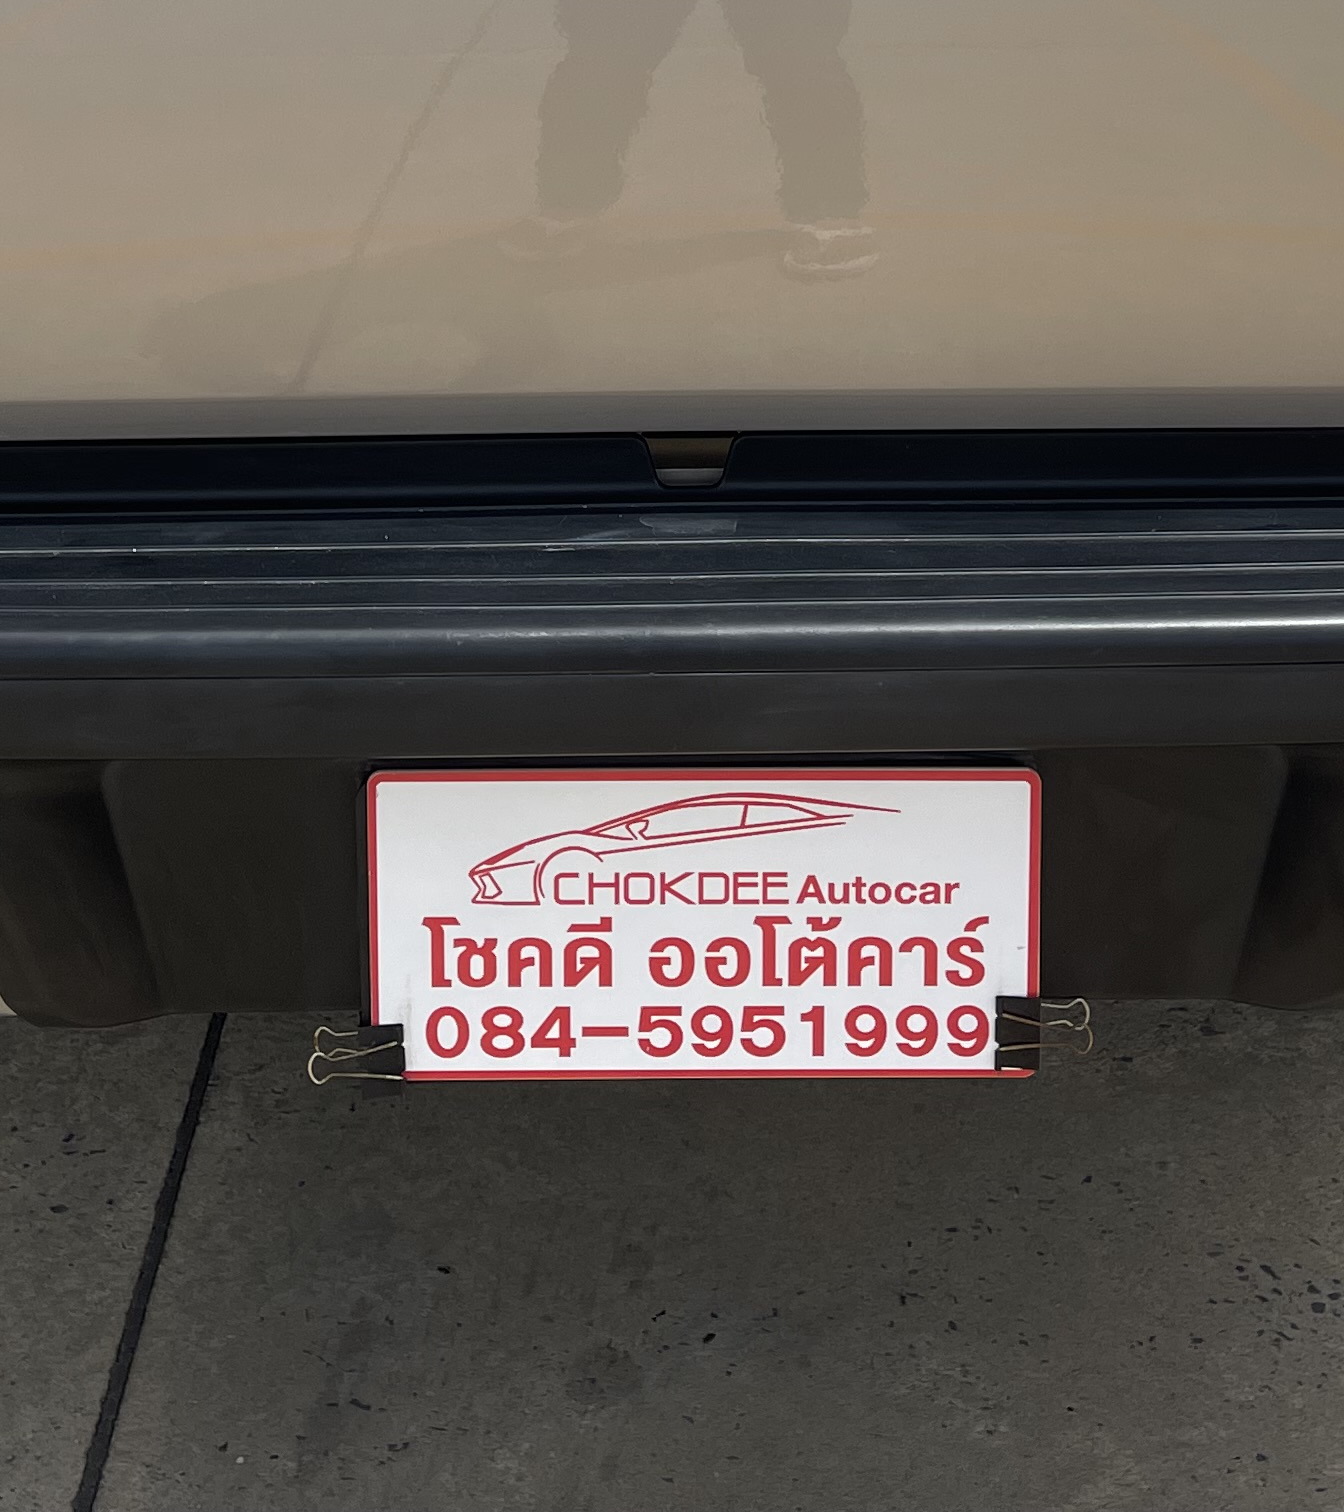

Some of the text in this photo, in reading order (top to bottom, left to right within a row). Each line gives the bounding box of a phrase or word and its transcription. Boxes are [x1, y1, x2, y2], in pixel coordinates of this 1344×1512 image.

[553, 871, 961, 906] CHOKDEE Autocar
[422, 915, 991, 988] โชคดี ออโต้คาร์
[424, 1004, 991, 1059] 084-5951999
